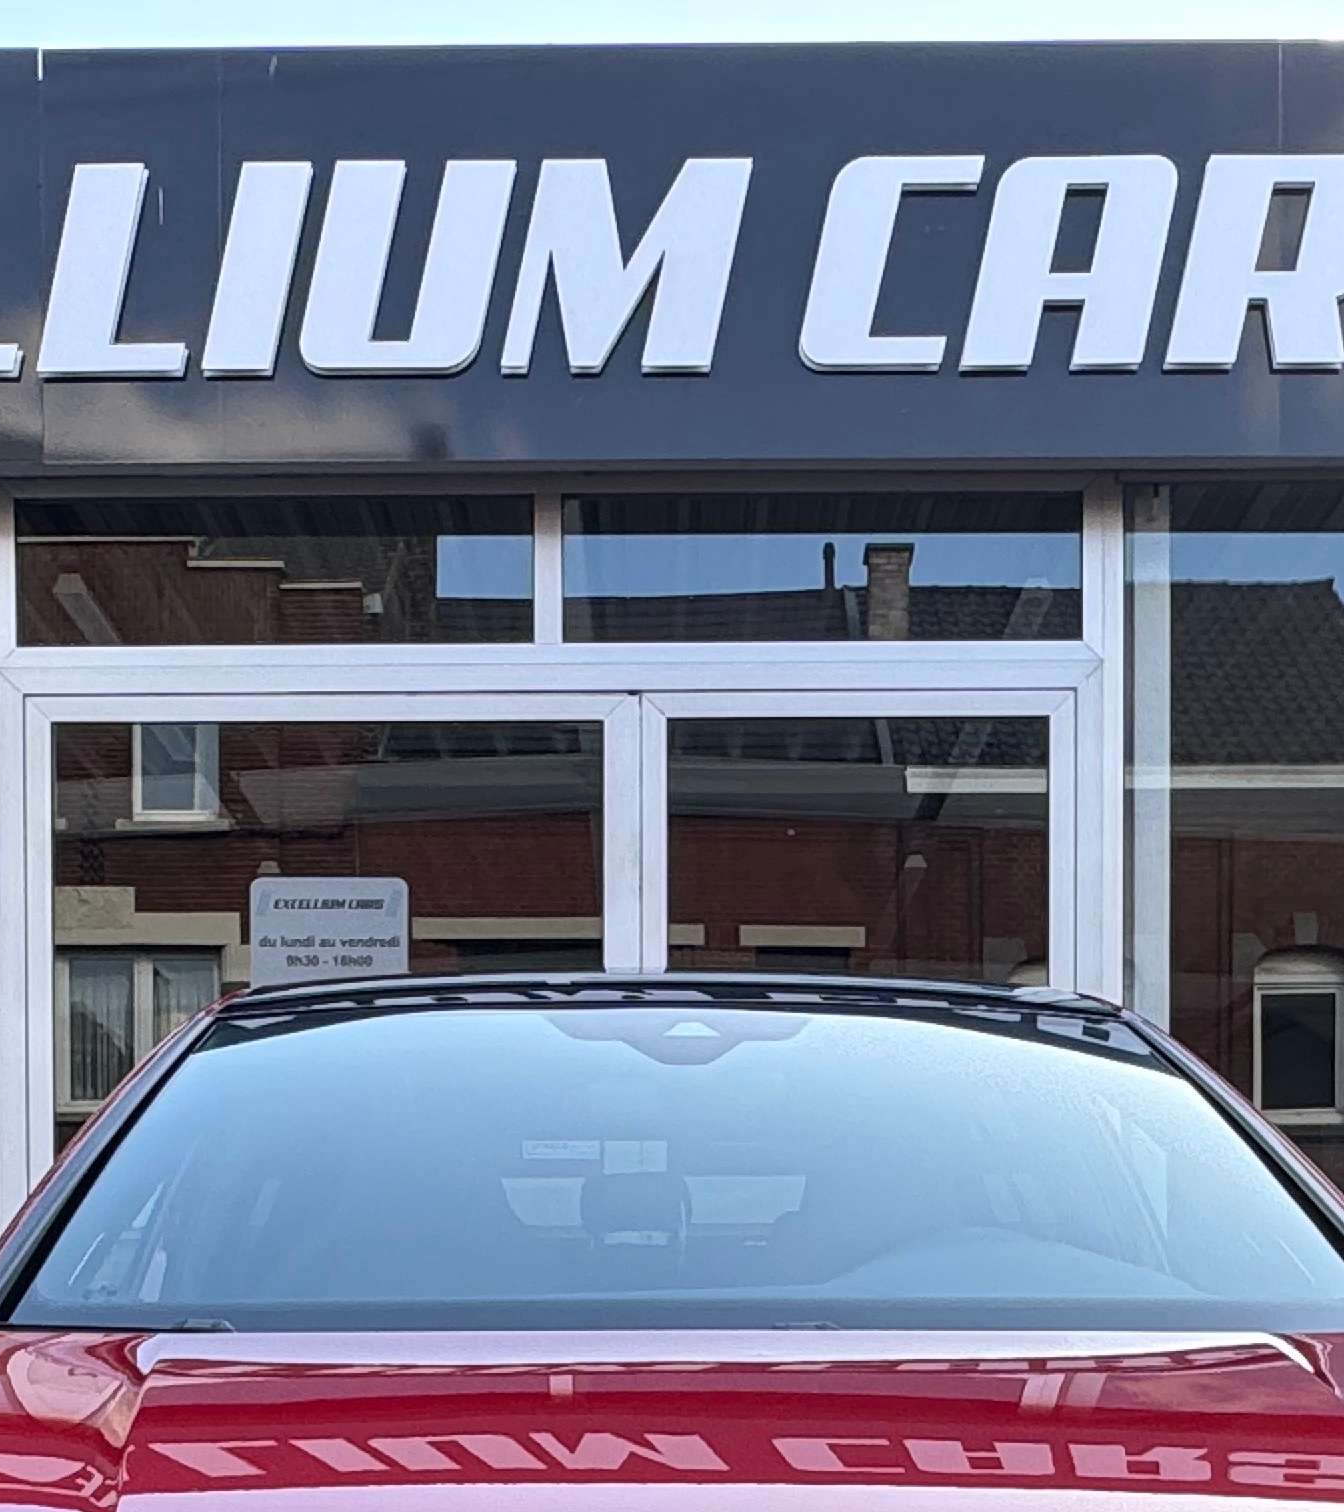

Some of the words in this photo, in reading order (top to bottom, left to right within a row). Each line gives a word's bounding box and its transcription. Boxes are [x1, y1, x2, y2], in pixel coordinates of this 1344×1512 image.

[259, 936, 277, 948] du
[281, 936, 316, 948] lundi
[318, 938, 337, 948] au
[340, 935, 401, 948] vendredi
